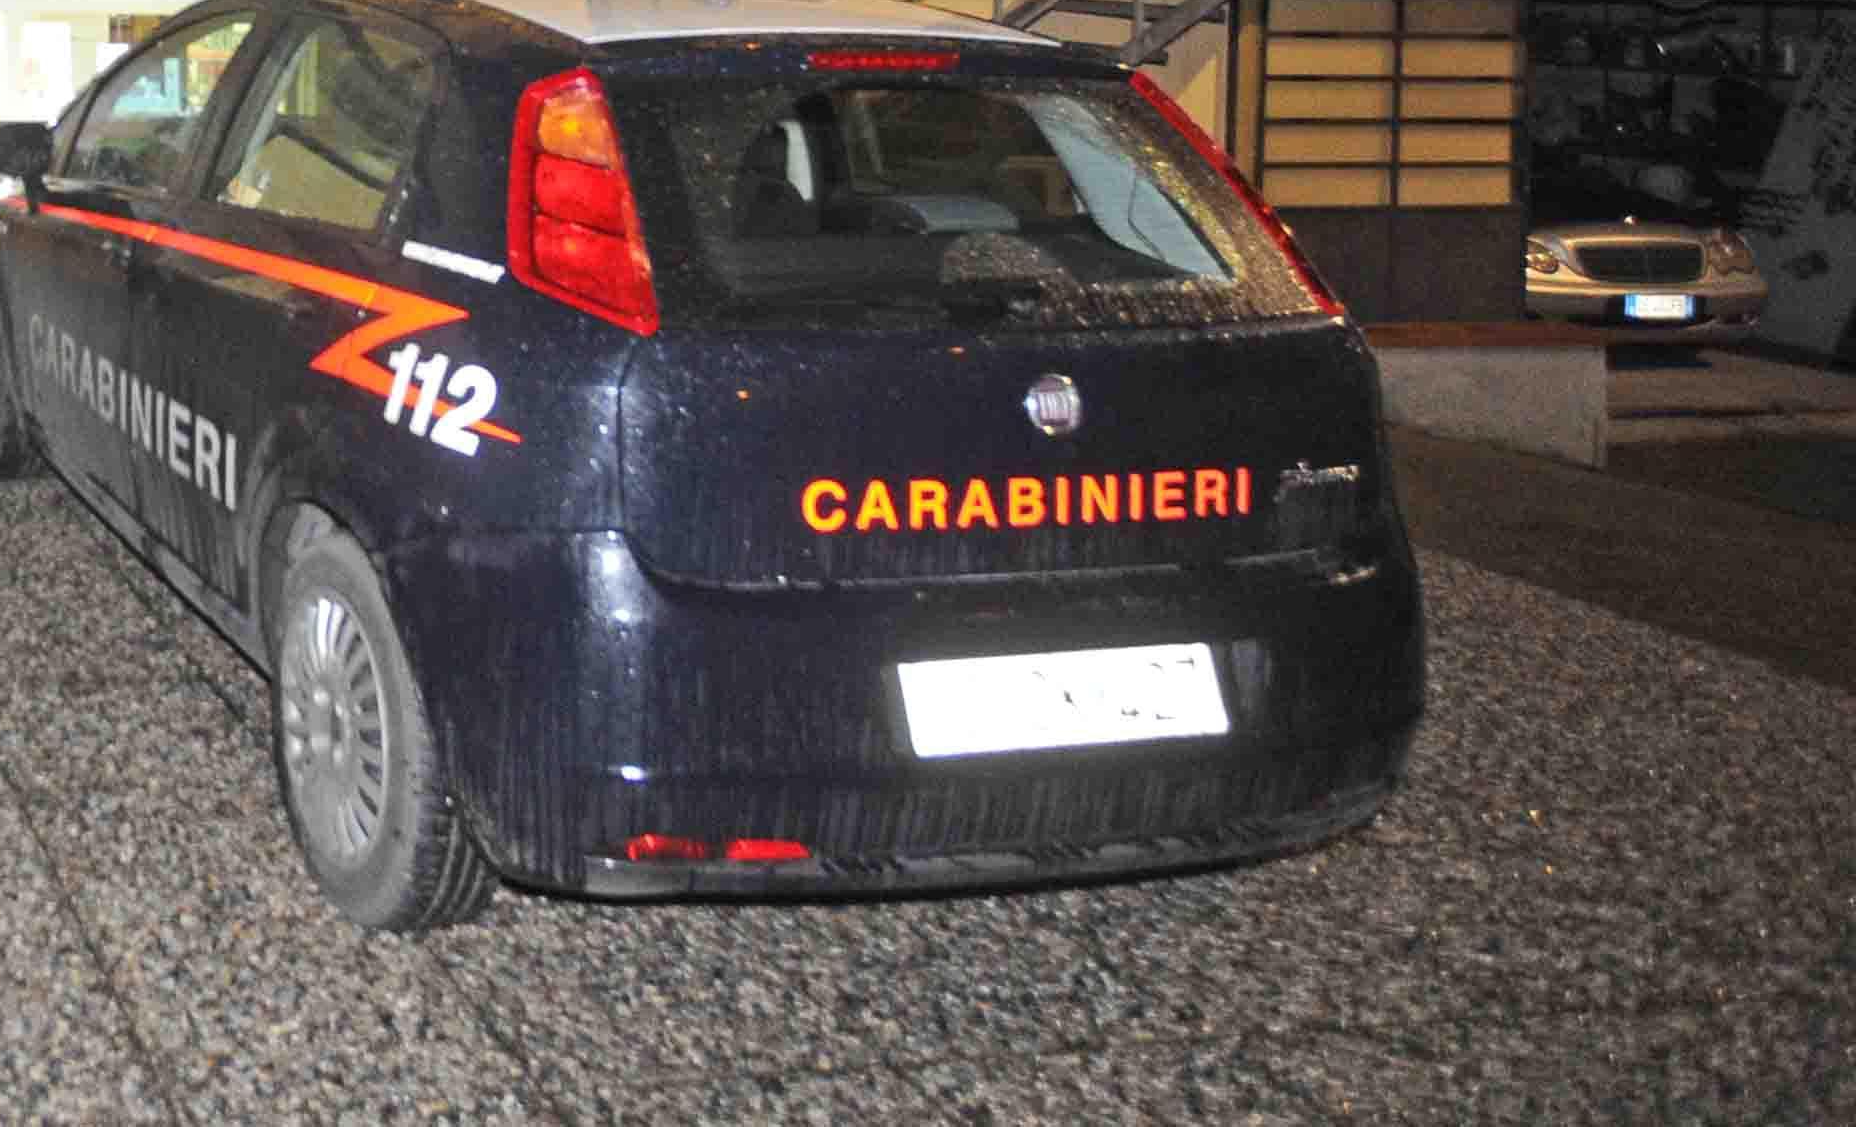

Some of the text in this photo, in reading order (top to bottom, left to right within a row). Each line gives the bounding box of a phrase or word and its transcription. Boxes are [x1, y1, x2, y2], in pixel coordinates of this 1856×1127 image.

[28, 314, 239, 511] CARABINIERI
[383, 342, 498, 457] 112
[800, 466, 1252, 533] CARABINIERI
